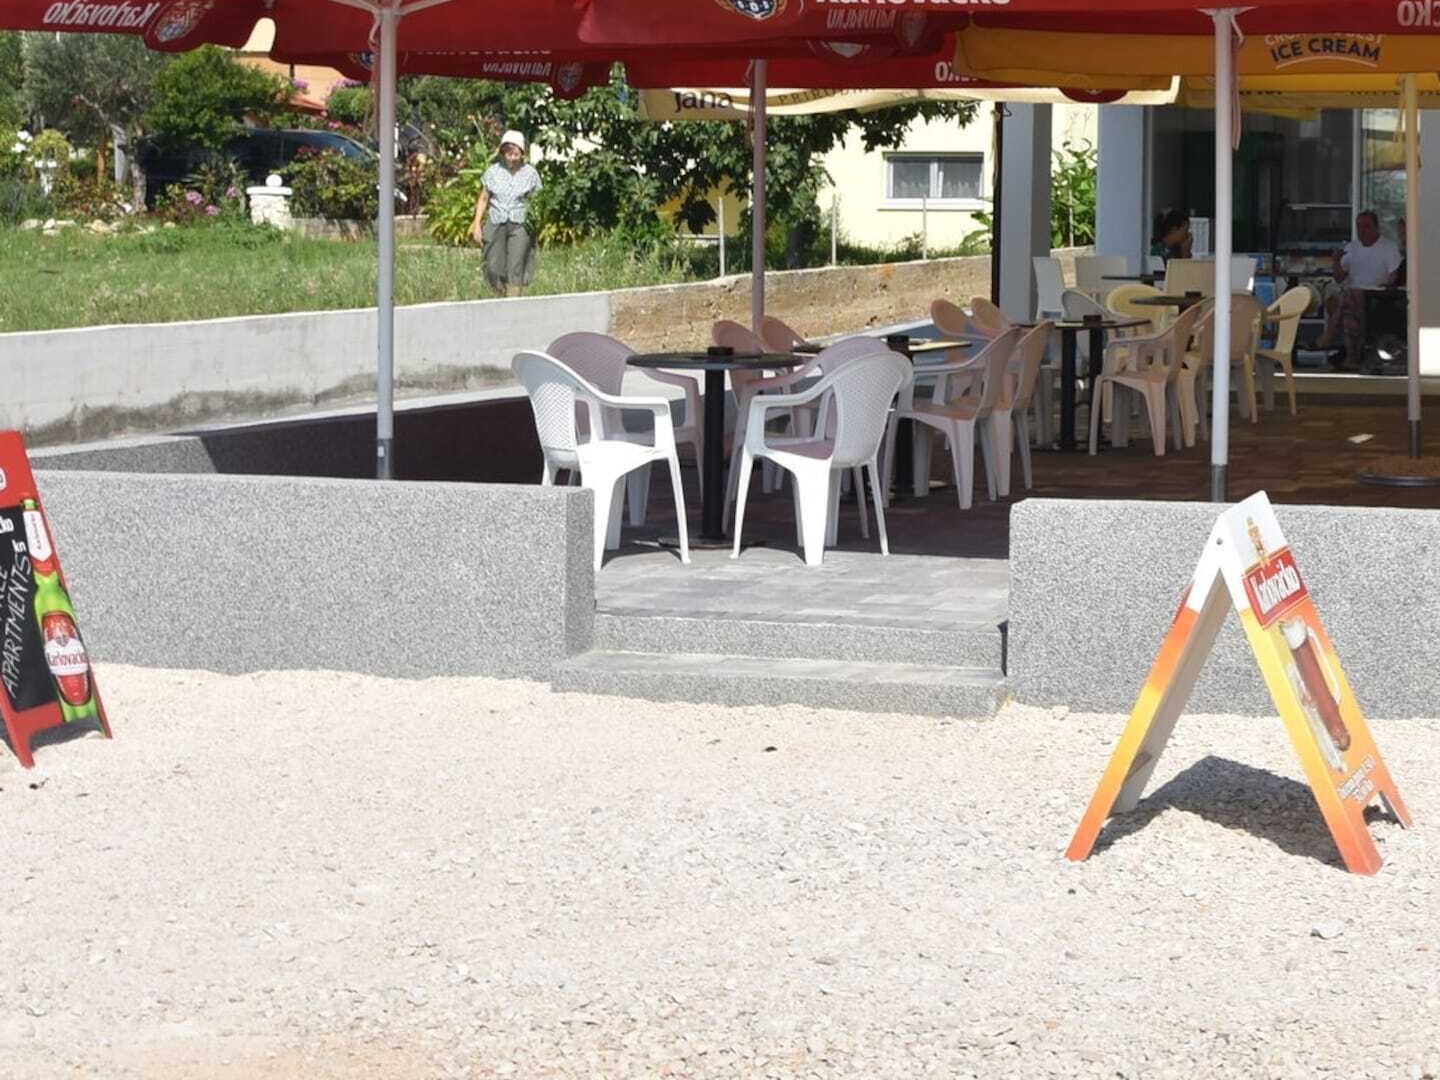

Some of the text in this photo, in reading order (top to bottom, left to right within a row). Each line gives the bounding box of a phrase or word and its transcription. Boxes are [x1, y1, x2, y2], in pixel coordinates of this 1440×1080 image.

[1271, 40, 1303, 63] ICE
[1308, 37, 1381, 62] CREAM
[1, 553, 32, 699] APARTMENTS
